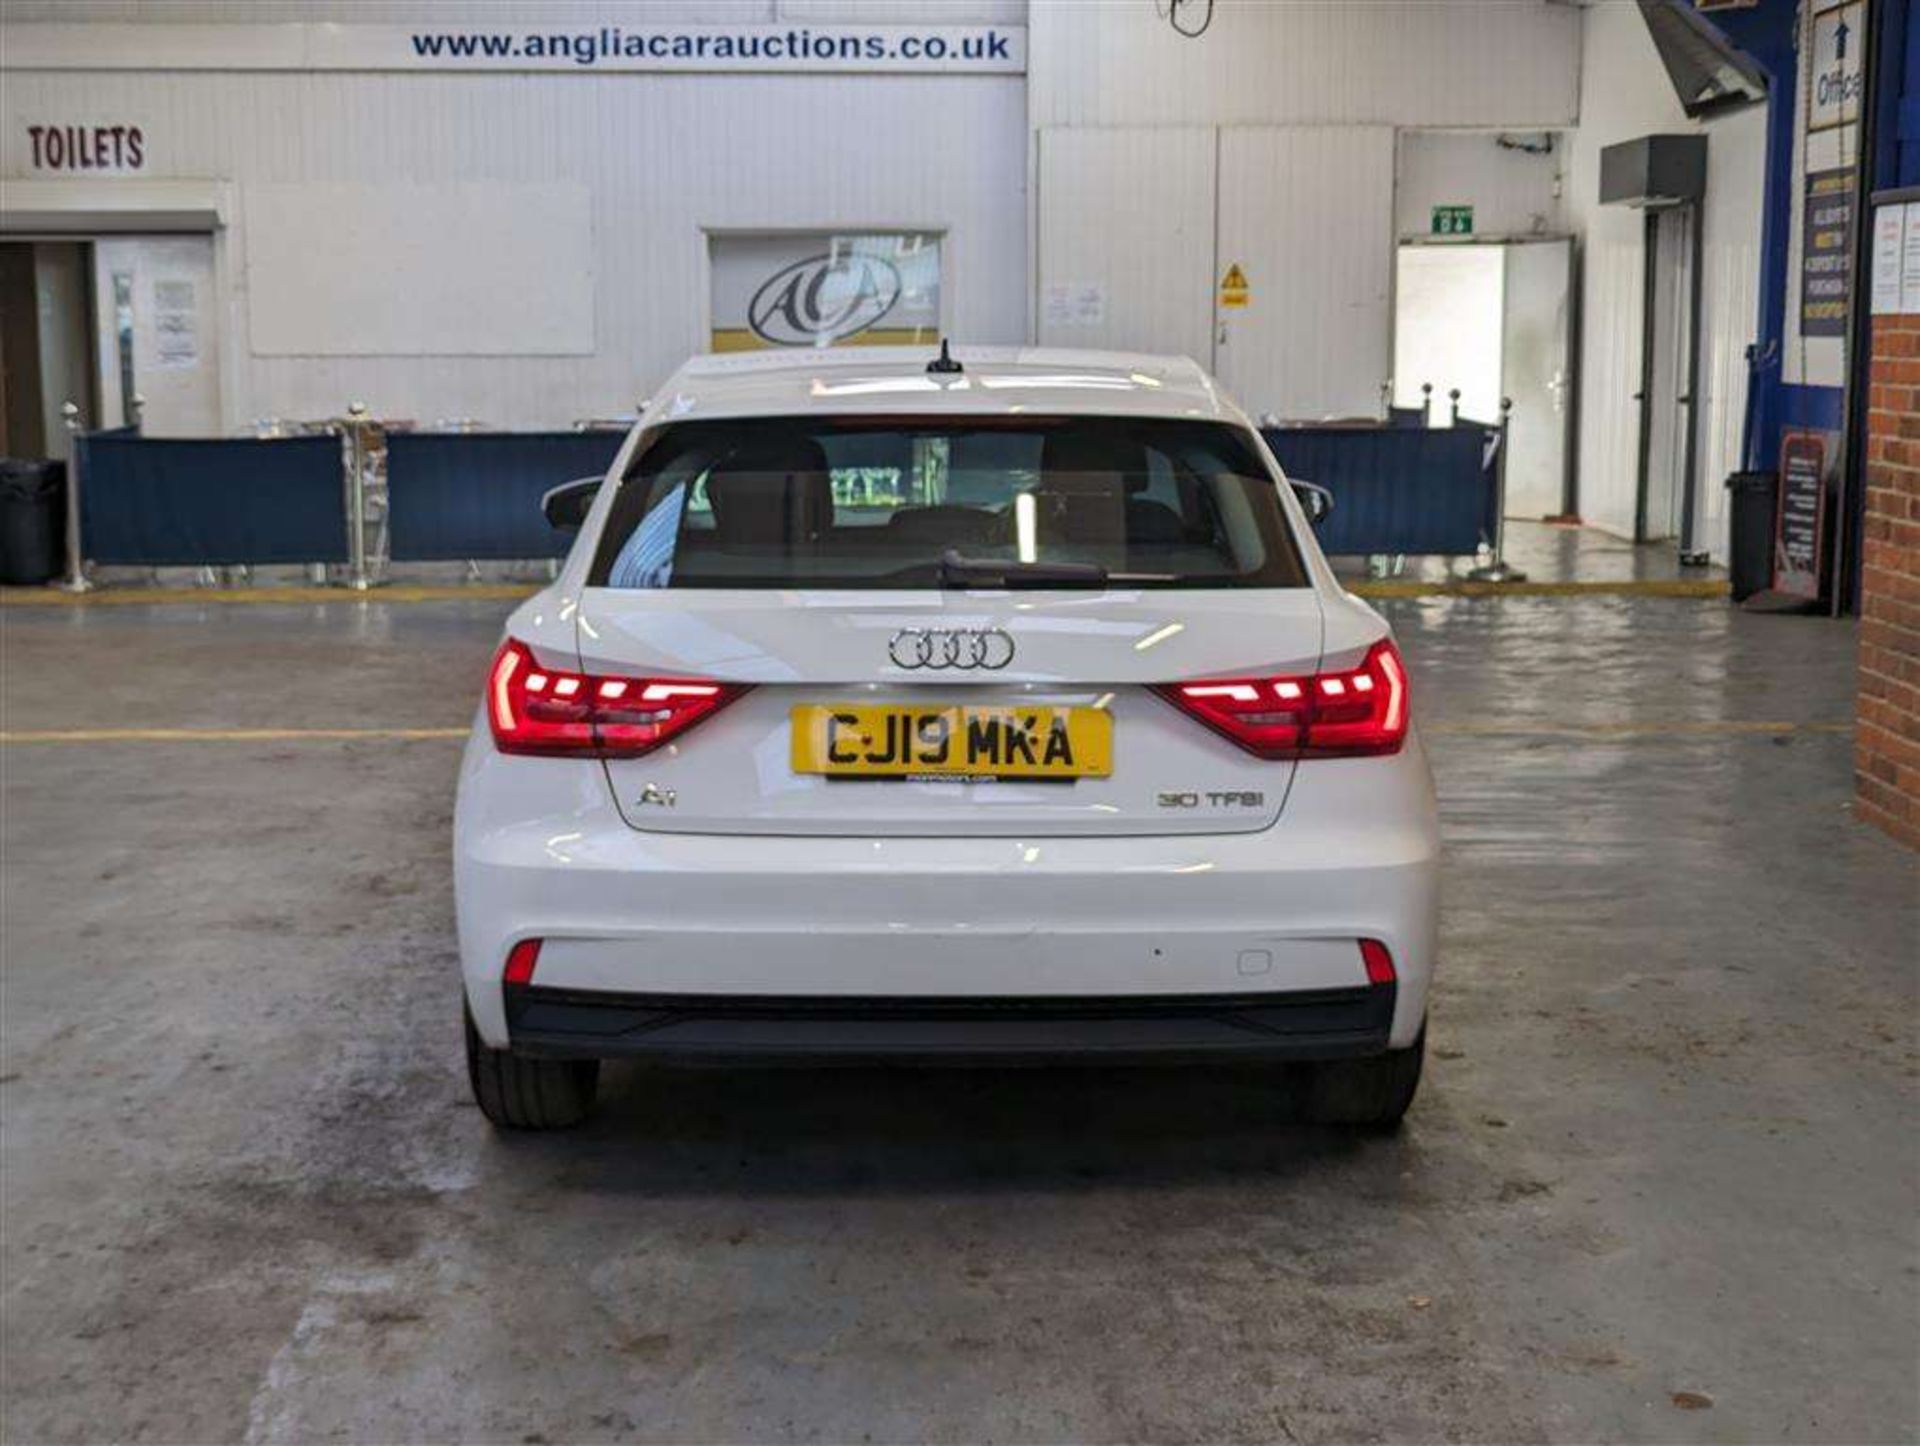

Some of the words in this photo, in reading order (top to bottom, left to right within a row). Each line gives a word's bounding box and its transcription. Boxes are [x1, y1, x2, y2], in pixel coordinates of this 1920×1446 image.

[412, 28, 1009, 64] www.angliacarauctions.co.uk
[27, 126, 142, 169] TOILETS
[827, 713, 949, 764] CJ19
[966, 714, 1074, 765] MKA
[1157, 792, 1198, 808] 30
[1205, 791, 1264, 807] TFSI
